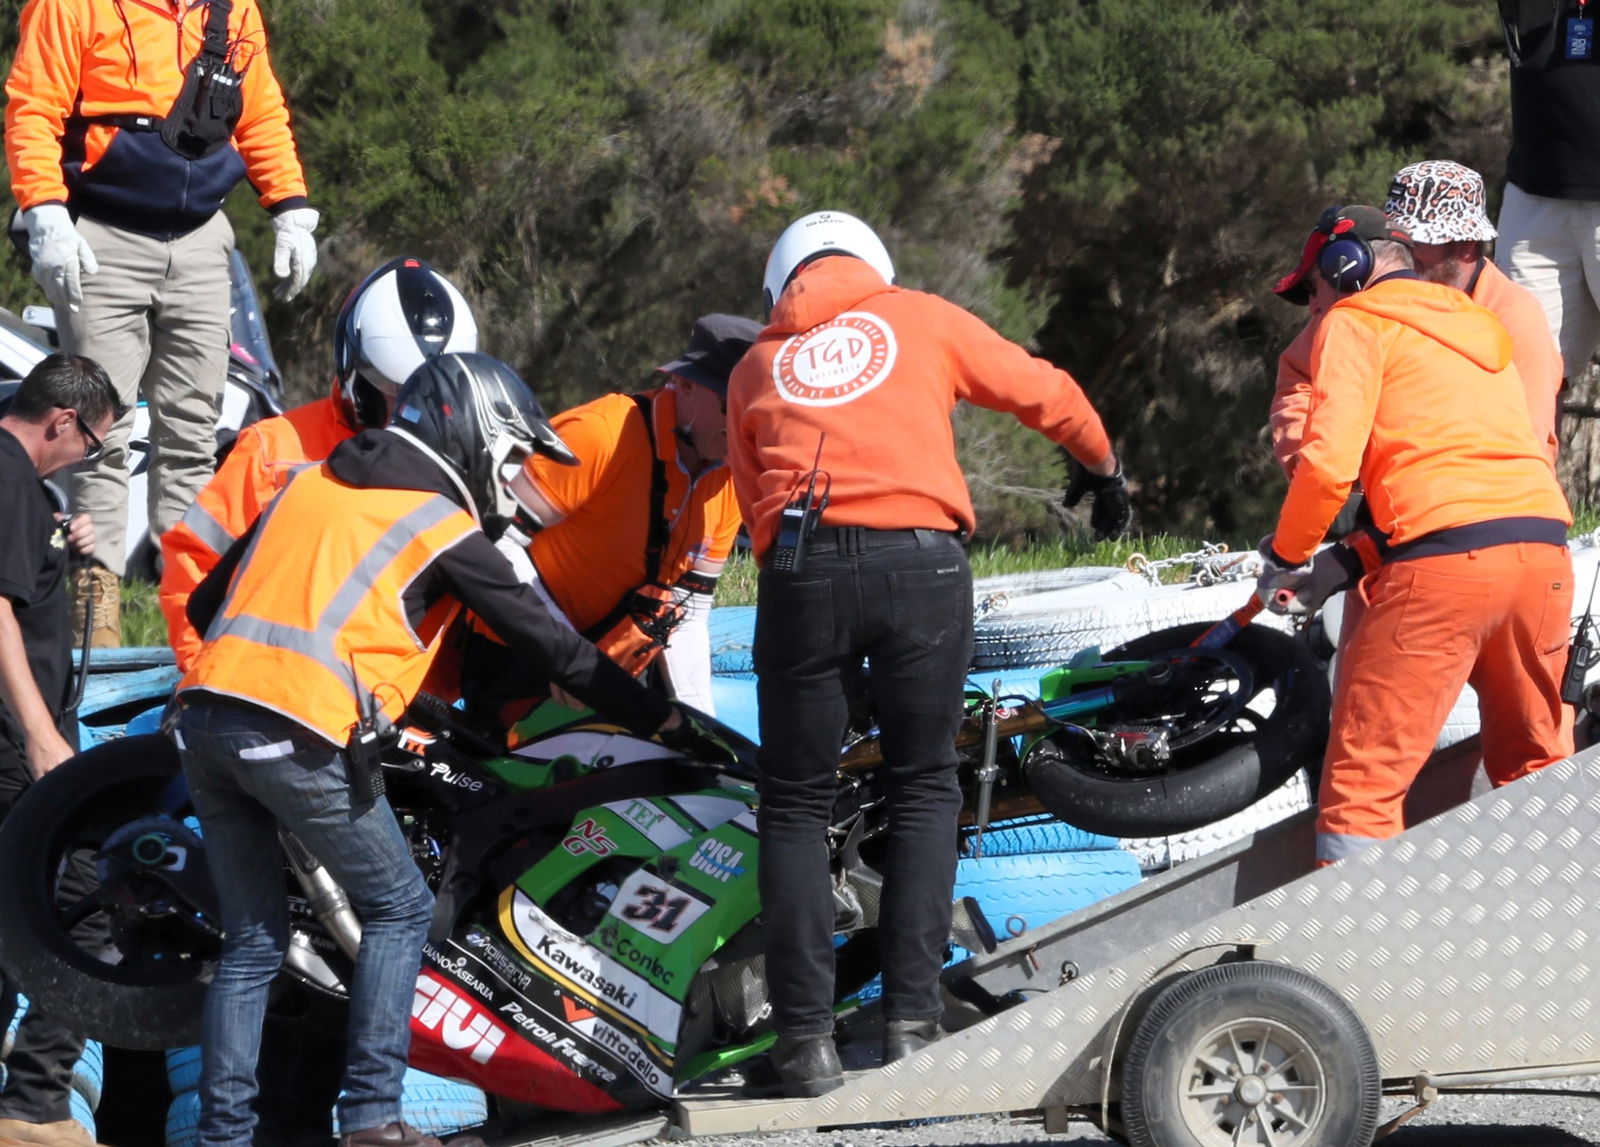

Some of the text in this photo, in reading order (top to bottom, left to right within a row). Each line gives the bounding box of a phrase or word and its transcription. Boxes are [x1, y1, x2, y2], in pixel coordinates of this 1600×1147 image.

[799, 337, 864, 370] TGD
[430, 762, 483, 791] Pulse
[689, 838, 744, 882] CISA
[621, 884, 691, 933] 31
[536, 934, 638, 1009] Kawasaki
